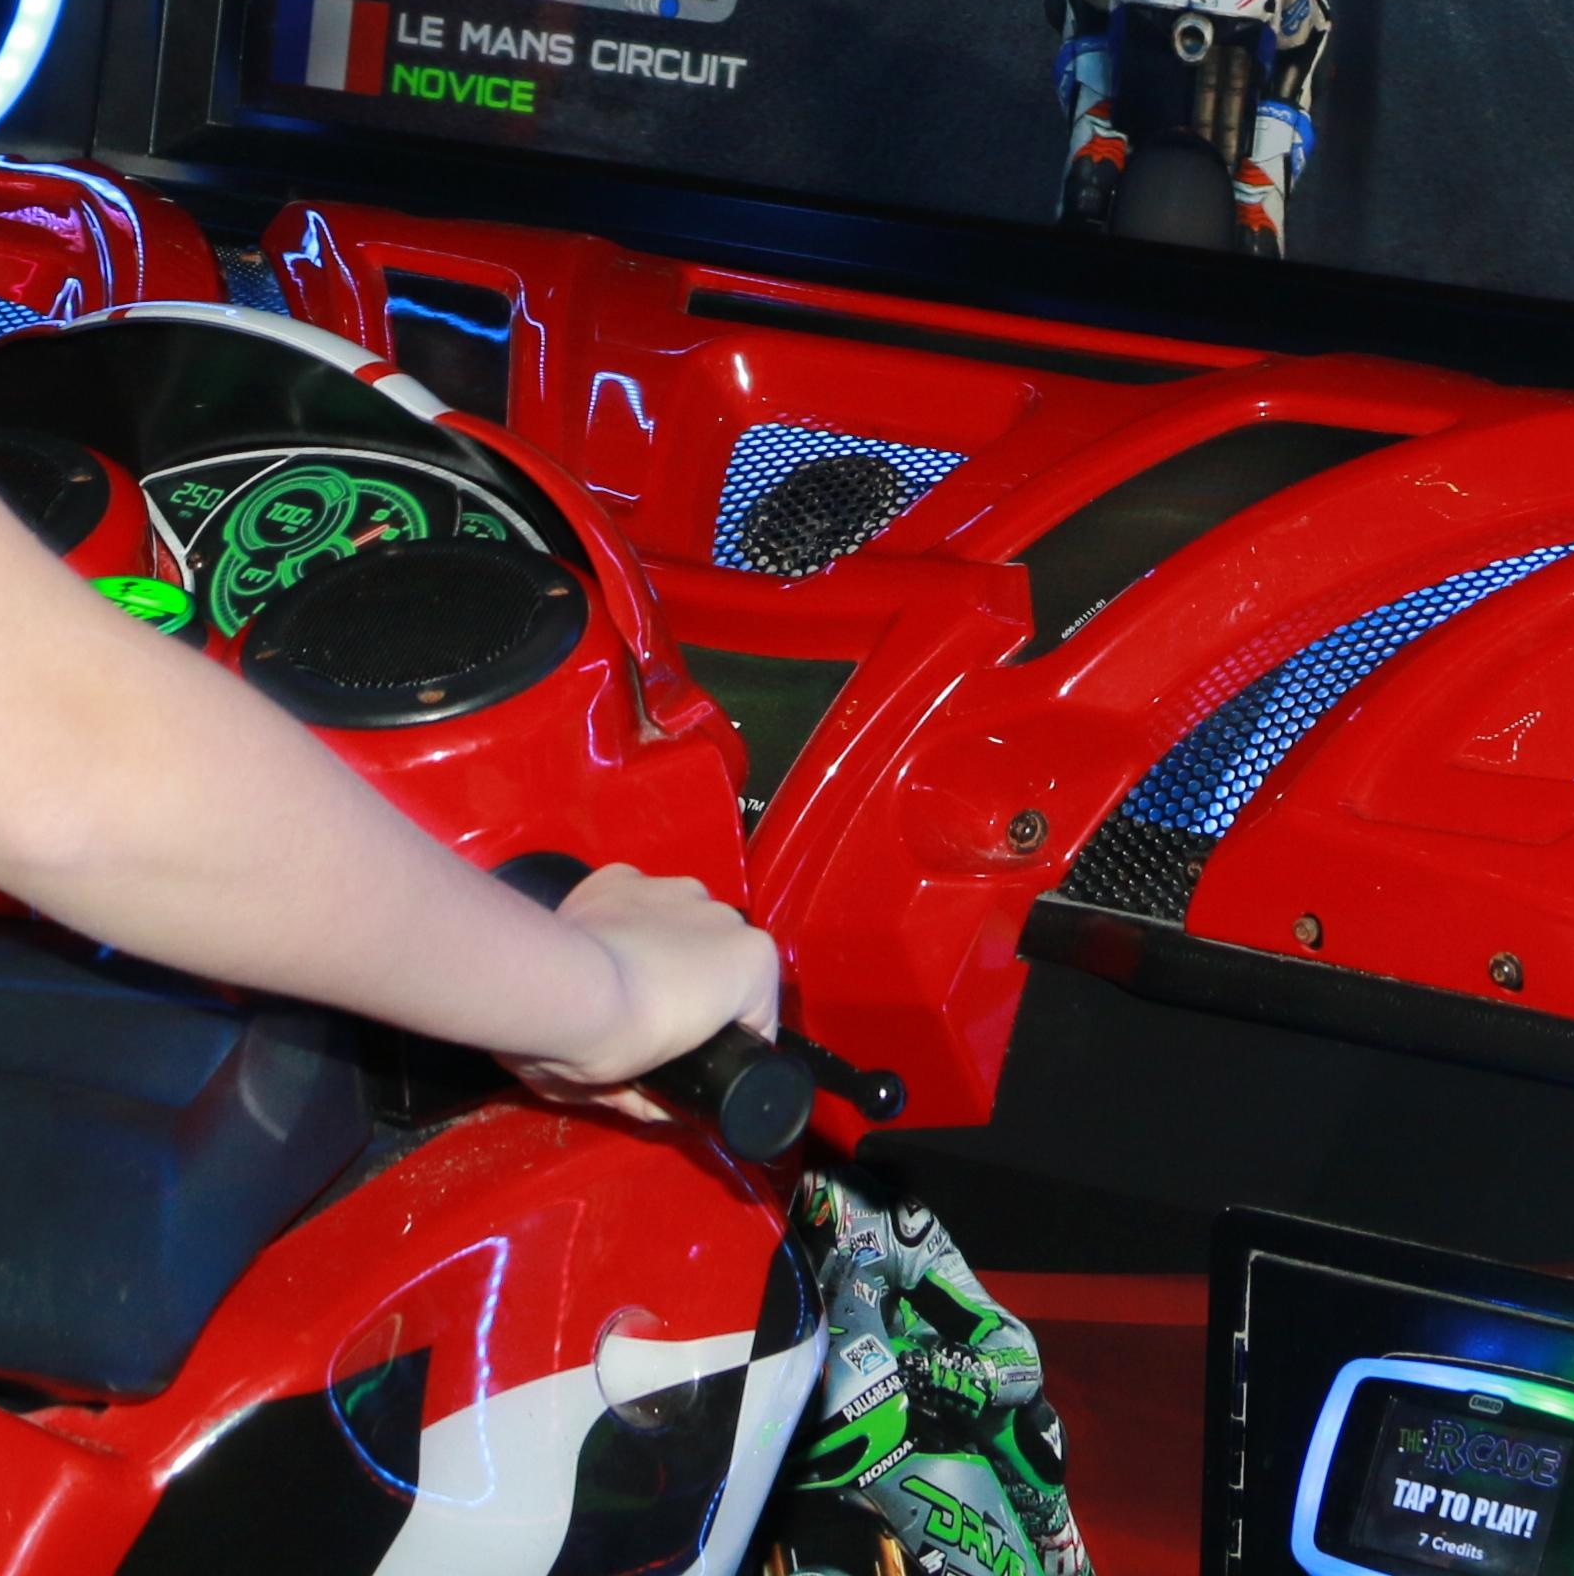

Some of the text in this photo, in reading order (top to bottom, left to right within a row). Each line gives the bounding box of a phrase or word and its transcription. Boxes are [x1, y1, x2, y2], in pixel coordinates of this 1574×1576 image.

[398, 12, 748, 90] LE MANS CIRCUIT
[390, 63, 536, 114] NOVICE
[170, 481, 225, 511] 250
[842, 1375, 905, 1423] PULL&BEAR
[857, 1439, 914, 1488] HONDA
[1399, 1428, 1424, 1453] THE
[1393, 1478, 1538, 1538] TAP TO PLAY!
[1418, 1532, 1484, 1560] 7 Credits
